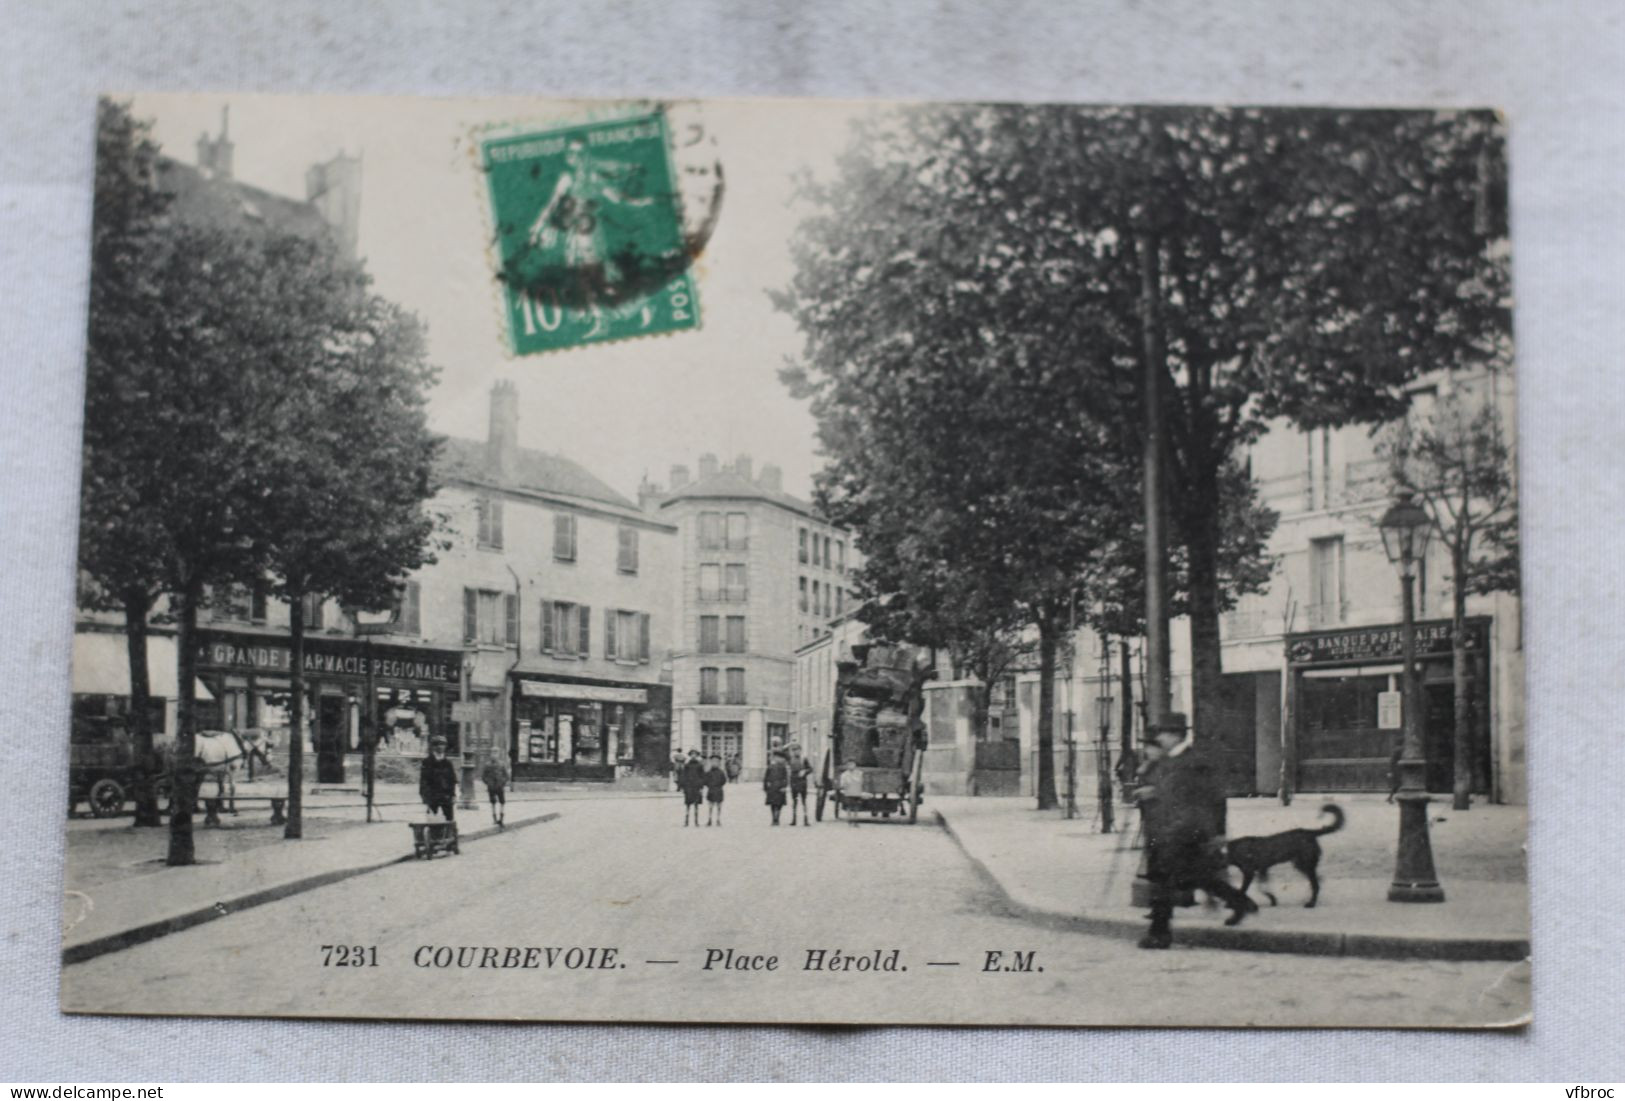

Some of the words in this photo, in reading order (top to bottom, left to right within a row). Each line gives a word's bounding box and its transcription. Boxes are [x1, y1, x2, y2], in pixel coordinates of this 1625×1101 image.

[515, 288, 562, 336] 10
[1317, 634, 1367, 649] BANQUE
[1370, 627, 1447, 646] POPUAIRE
[213, 645, 279, 667] GRANDE
[286, 651, 367, 675] PARMACIE
[372, 658, 448, 681] REGIONALE
[321, 945, 379, 968] 7231
[413, 945, 626, 970] COURBEVOIE.
[702, 948, 778, 971] Place
[803, 949, 907, 972] Hérold.
[982, 950, 1044, 973] E.M.
